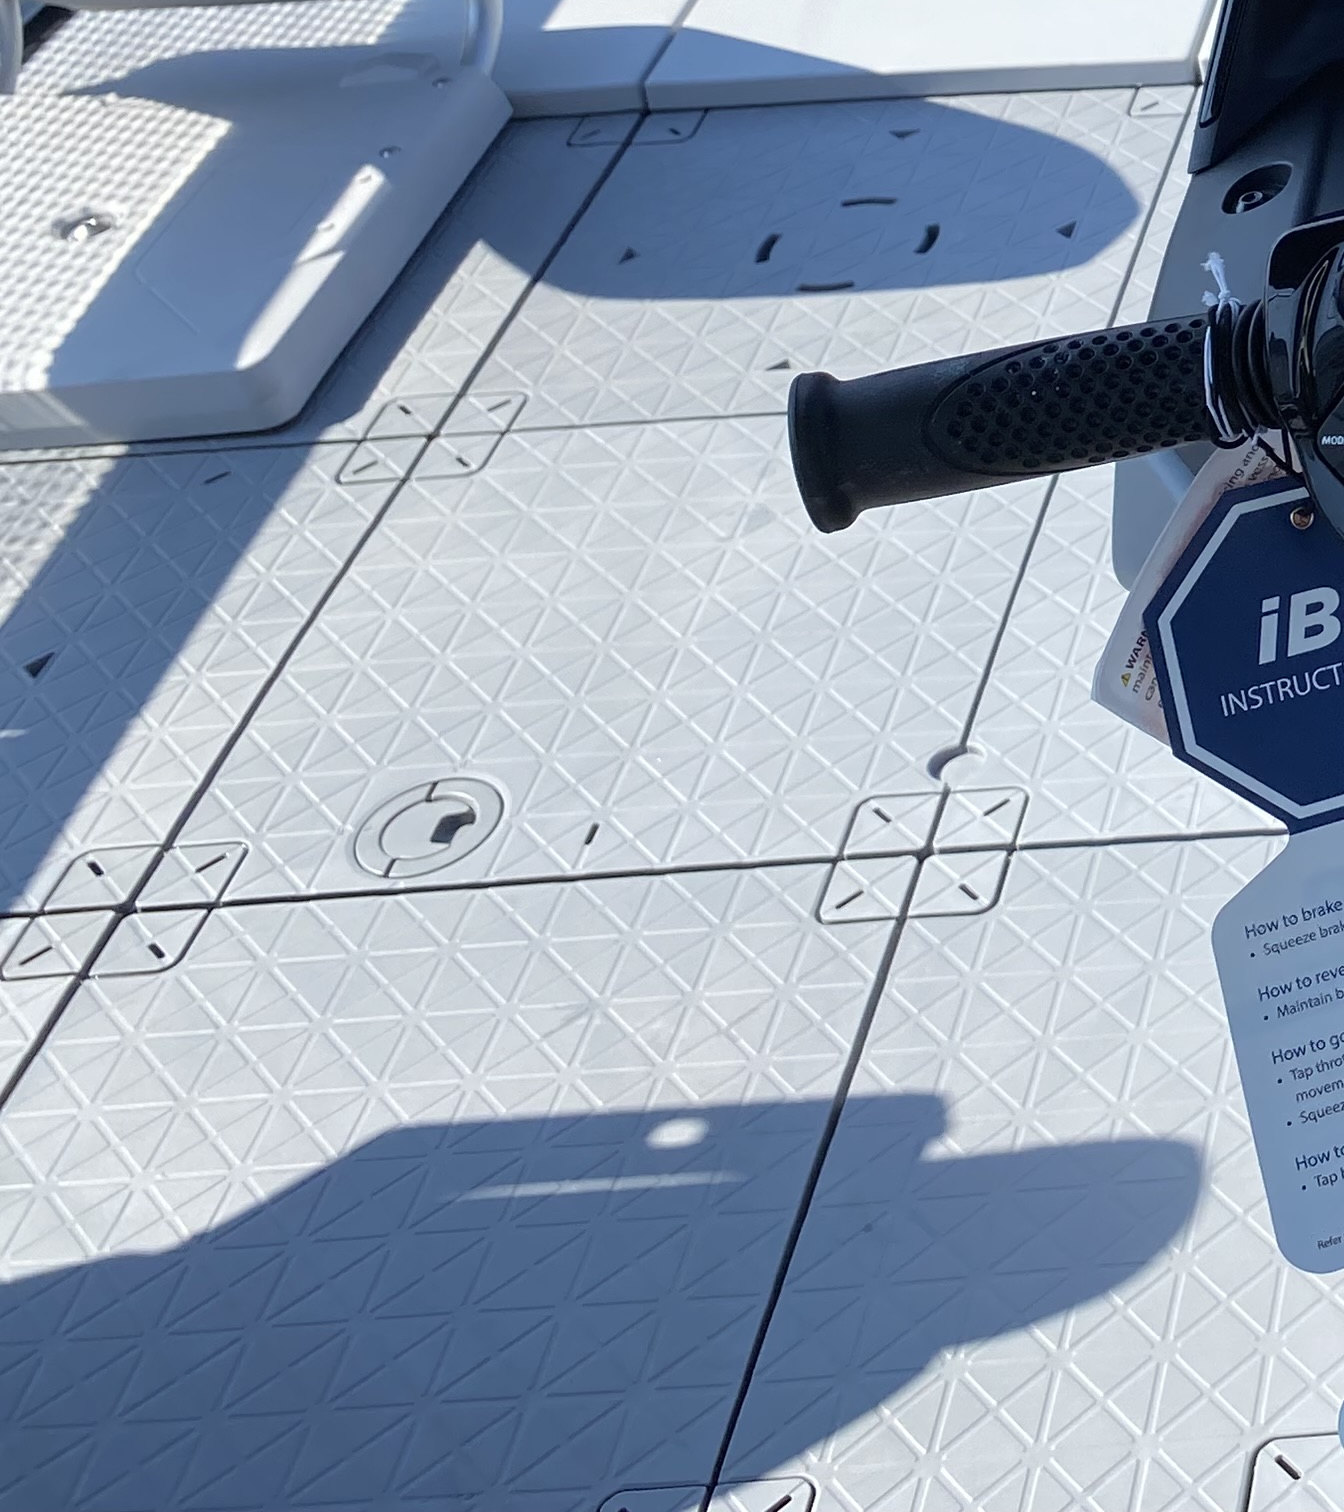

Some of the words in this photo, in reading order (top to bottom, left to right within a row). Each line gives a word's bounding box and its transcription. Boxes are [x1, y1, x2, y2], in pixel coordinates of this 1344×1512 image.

[1244, 919, 1278, 939] How
[1282, 914, 1298, 927] to
[1301, 899, 1342, 921] brake
[1263, 931, 1316, 955] Squeeze
[1257, 981, 1292, 1001] How
[1295, 976, 1312, 989] to
[1276, 992, 1333, 1018] Maintain
[1271, 1044, 1306, 1064] How
[1309, 1039, 1325, 1052] to
[1290, 1066, 1313, 1080] Tap
[1295, 1150, 1330, 1170] How
[1314, 1172, 1337, 1187] Tap
[1317, 1235, 1341, 1249] Refer
